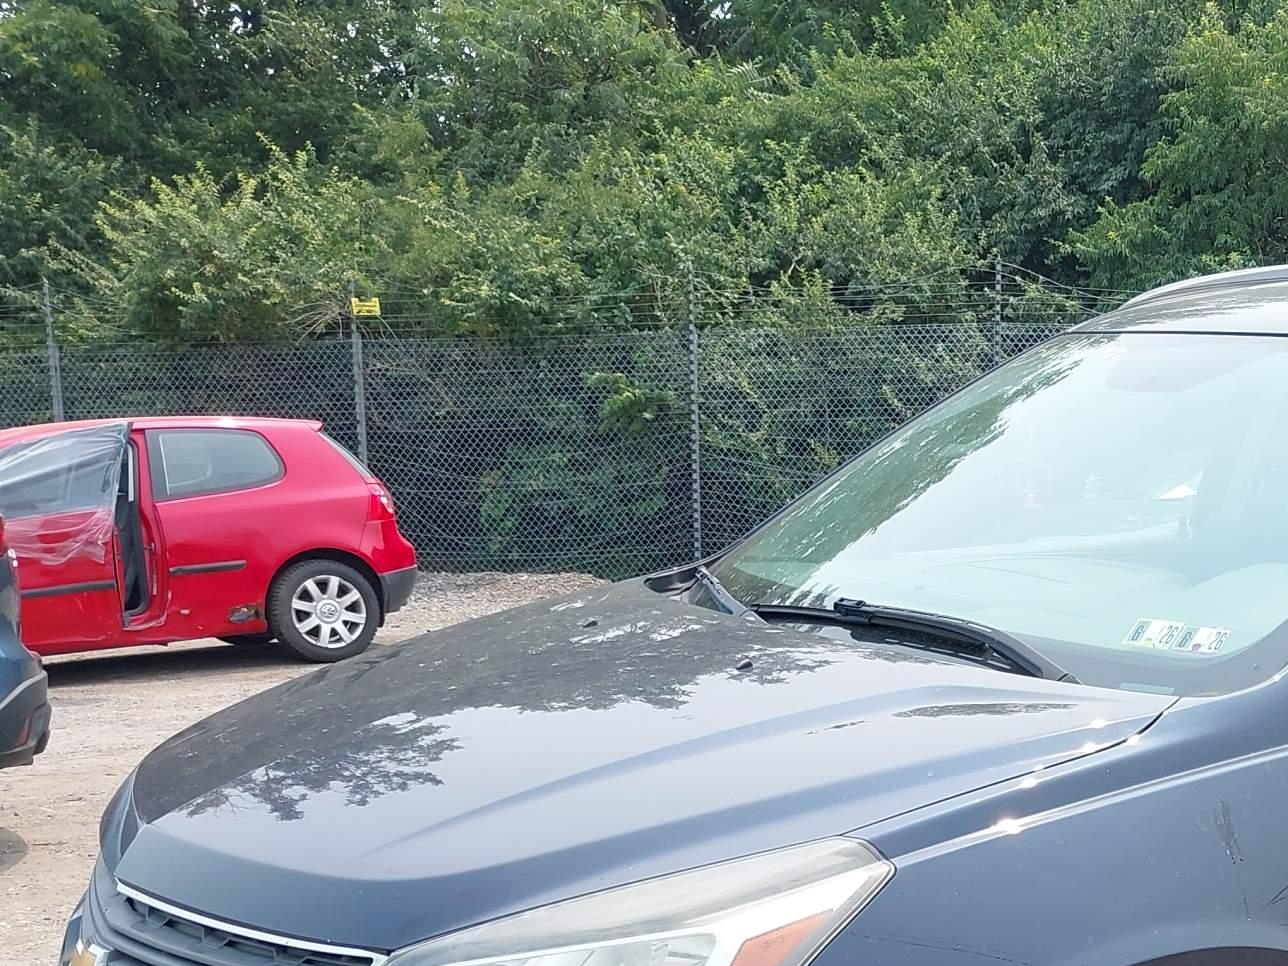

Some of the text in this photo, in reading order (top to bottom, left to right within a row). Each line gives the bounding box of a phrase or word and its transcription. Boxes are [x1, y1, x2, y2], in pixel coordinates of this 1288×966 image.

[1131, 624, 1178, 645] 6 26
[1178, 631, 1227, 650] 6 26
